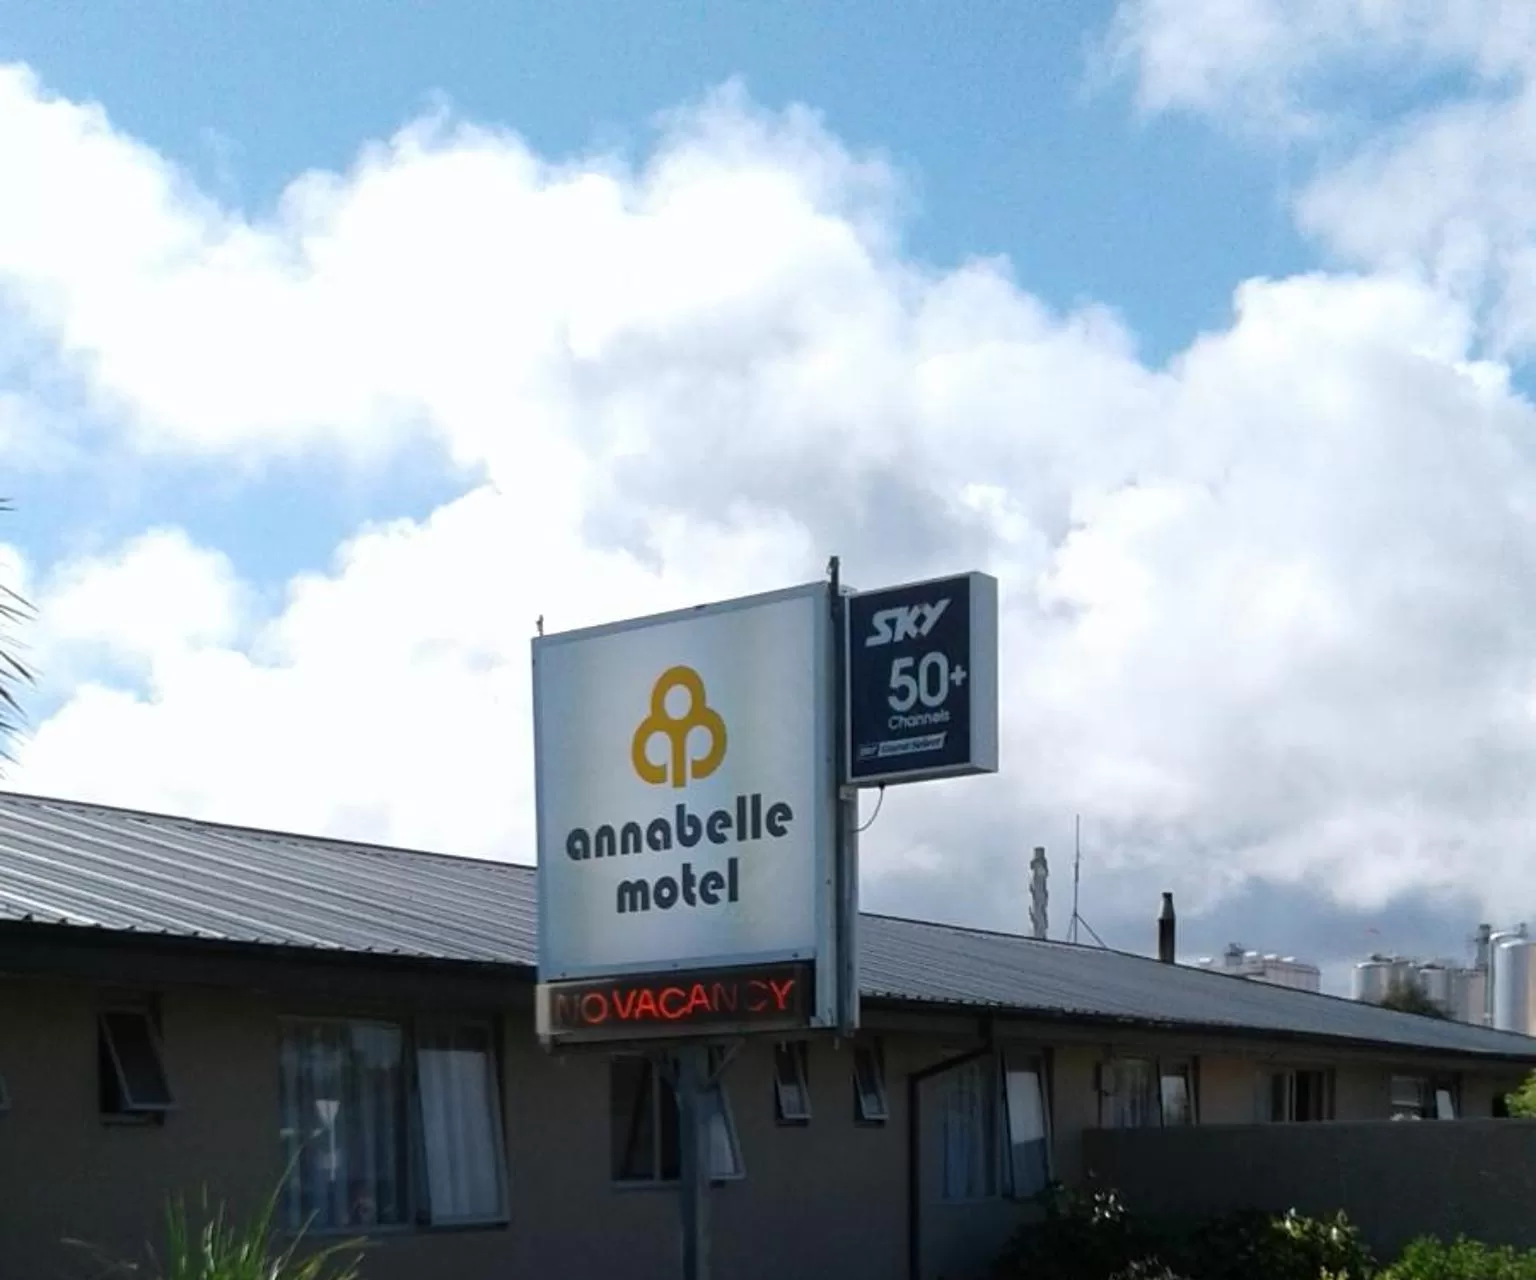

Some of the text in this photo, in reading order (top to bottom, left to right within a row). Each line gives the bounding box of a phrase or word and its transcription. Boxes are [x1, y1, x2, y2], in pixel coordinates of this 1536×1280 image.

[865, 598, 951, 647] SKY
[888, 651, 967, 712] 50+
[888, 709, 950, 730] Channels
[565, 793, 793, 861] annabelle
[616, 857, 739, 914] motel
[611, 979, 796, 1021] VACANCY
